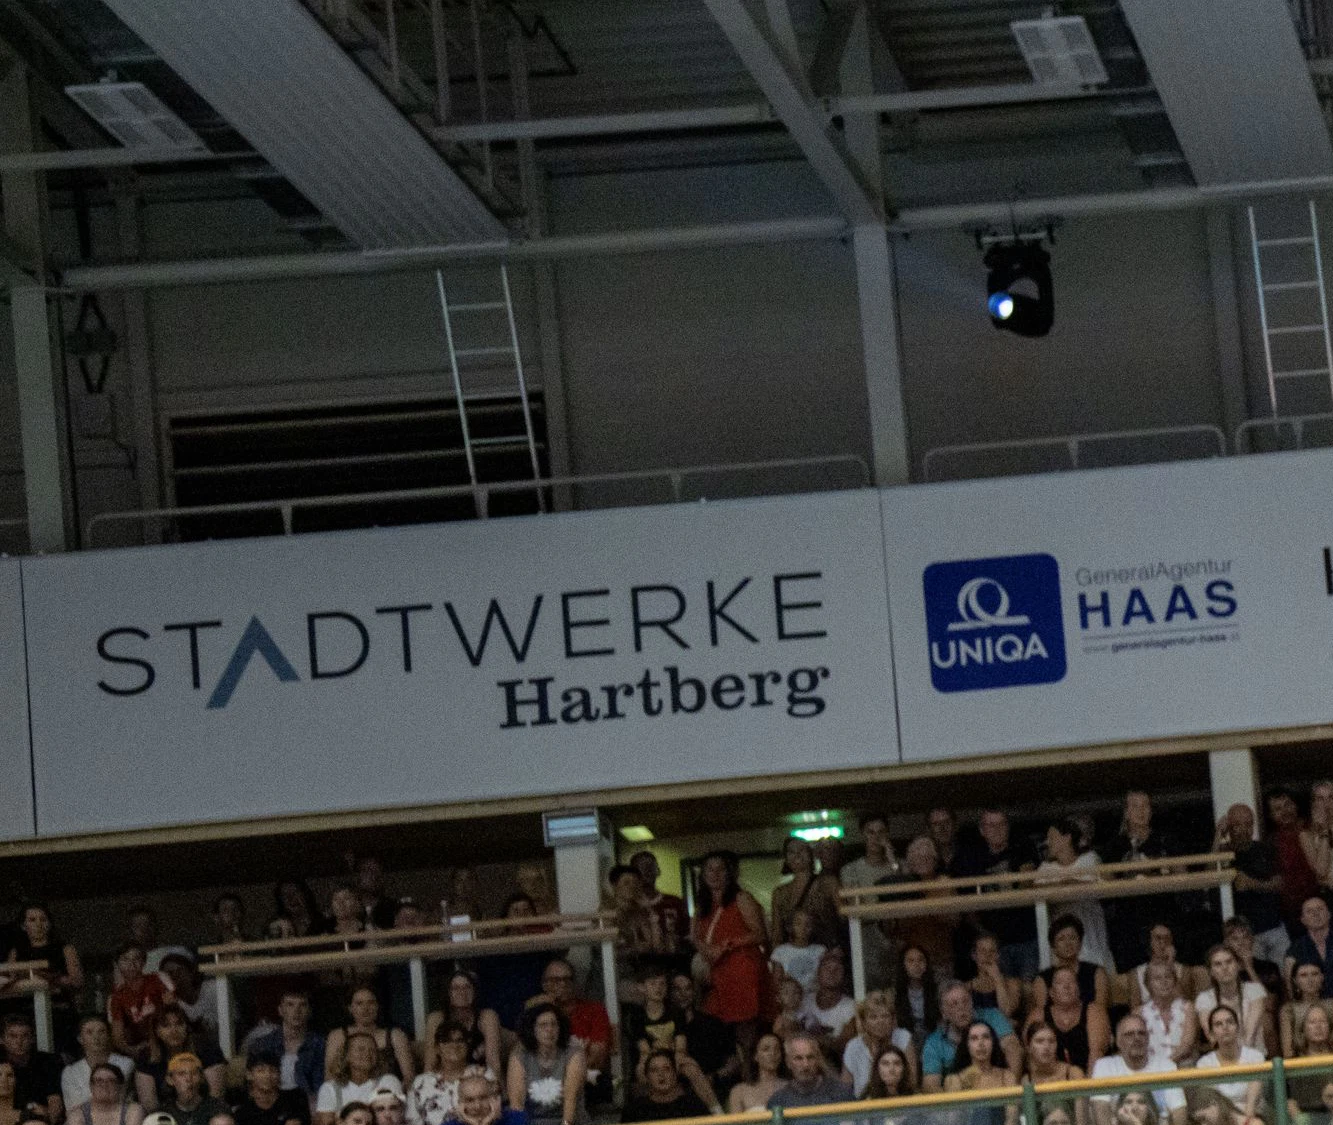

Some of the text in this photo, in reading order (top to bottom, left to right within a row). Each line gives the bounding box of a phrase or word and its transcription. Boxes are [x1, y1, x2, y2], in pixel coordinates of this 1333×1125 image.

[1075, 558, 1232, 587] GeneralAgentur
[1077, 579, 1238, 630] HAAS
[95, 571, 829, 710] STADTWERKE
[931, 632, 1048, 669] UNIQA
[497, 664, 831, 730] Hartberg
